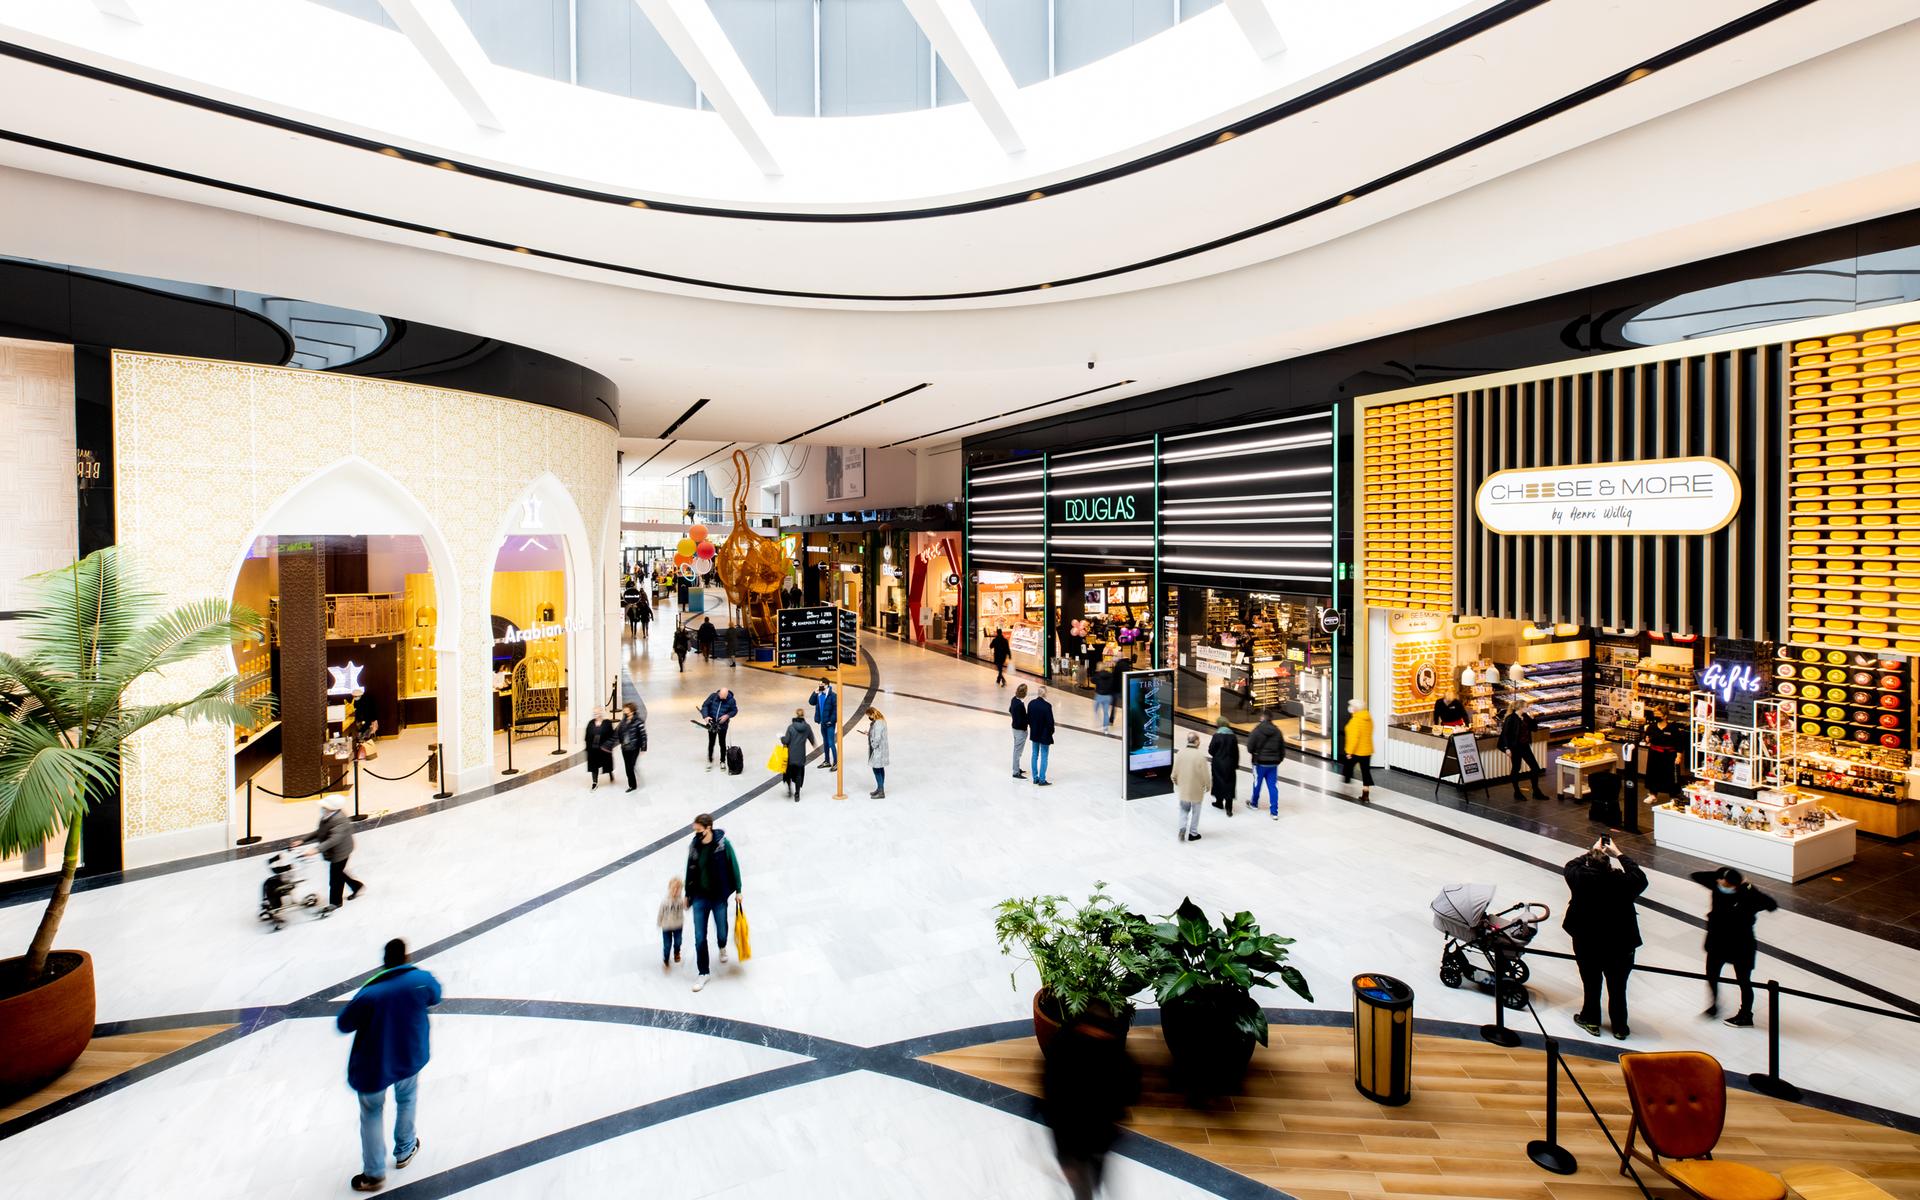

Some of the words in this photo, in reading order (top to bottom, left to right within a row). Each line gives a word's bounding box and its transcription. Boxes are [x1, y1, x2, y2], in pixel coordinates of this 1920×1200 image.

[1490, 480, 1593, 500] CHEESE
[1598, 479, 1615, 496] &
[1621, 474, 1714, 495] MORE
[1065, 495, 1135, 521] DOUGLAS
[1551, 507, 1563, 524] by
[1570, 506, 1596, 521] Henri
[1603, 505, 1633, 527] Willig
[504, 621, 562, 644] Arabian
[563, 614, 585, 633] Oud
[1703, 663, 1761, 703] Gifts
